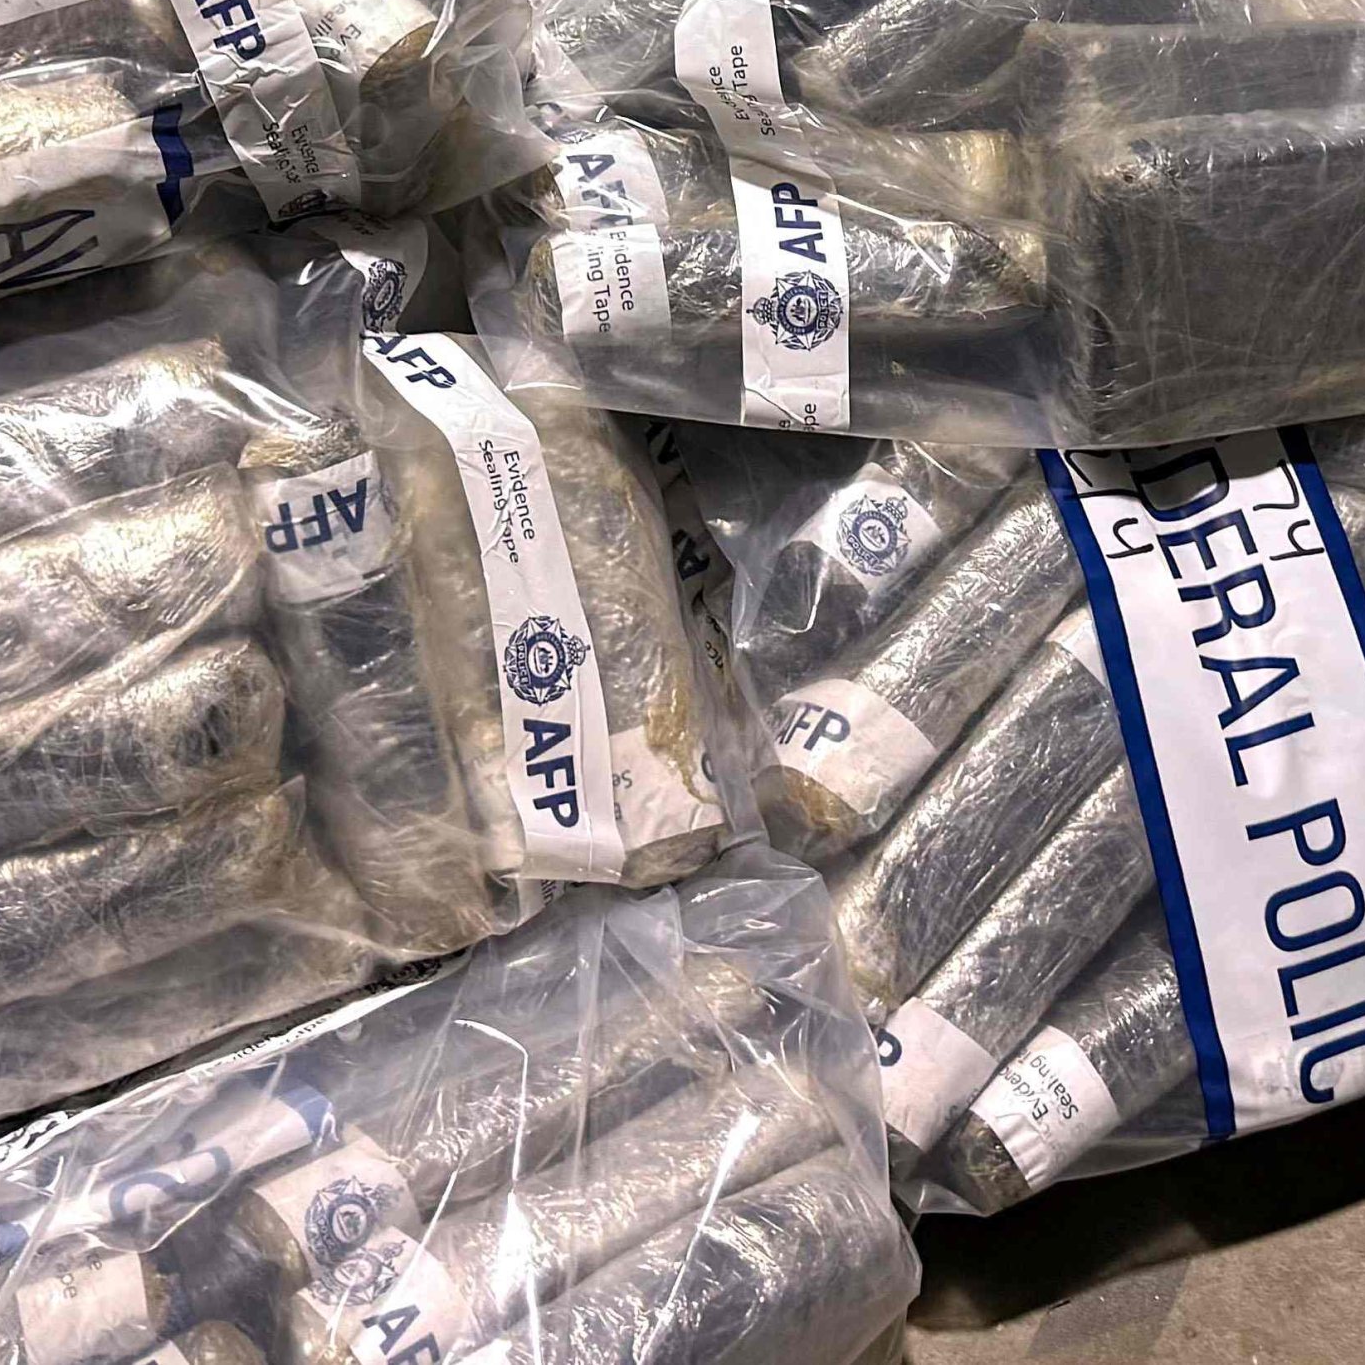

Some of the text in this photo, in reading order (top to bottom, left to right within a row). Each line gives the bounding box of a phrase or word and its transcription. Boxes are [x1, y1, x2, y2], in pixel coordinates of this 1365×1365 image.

[769, 181, 827, 265] AFP
[592, 283, 611, 333] Tape
[360, 331, 457, 389] AFP
[477, 437, 506, 512] Sealing
[503, 449, 536, 541] Evidence
[1252, 459, 1325, 563] 74
[265, 478, 369, 555] AFP
[522, 717, 580, 829] AFP
